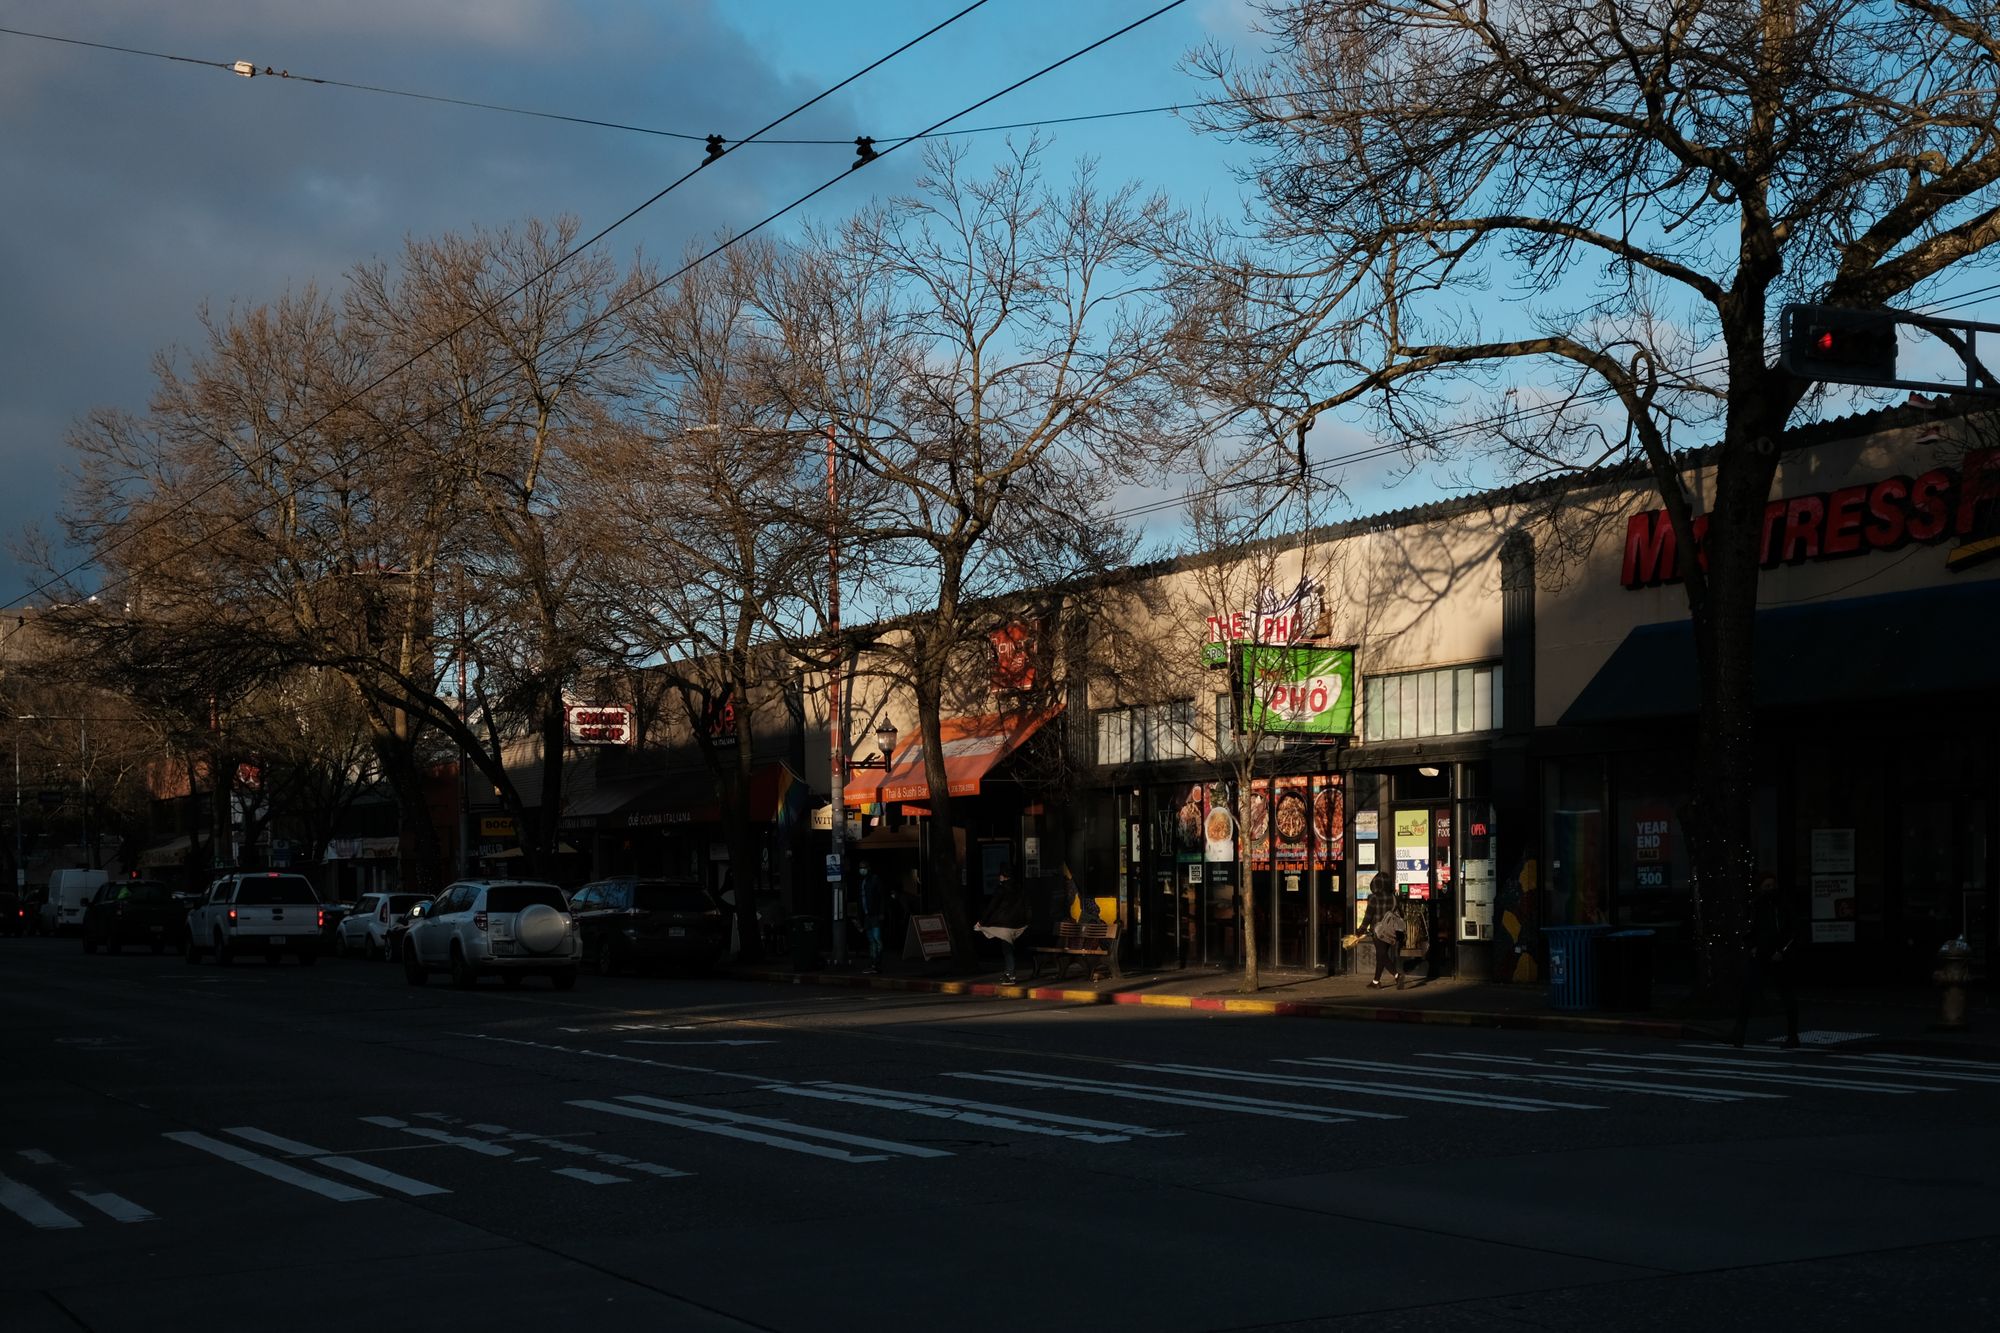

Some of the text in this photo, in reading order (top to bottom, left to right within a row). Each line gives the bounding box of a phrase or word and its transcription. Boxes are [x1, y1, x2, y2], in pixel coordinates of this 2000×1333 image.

[1620, 466, 1952, 590] MTRESS
[1206, 611, 1244, 642] THE
[576, 711, 627, 725] SMOKE
[580, 727, 624, 741] SHOP
[885, 788, 897, 799] Thai
[897, 787, 903, 799] &
[902, 786, 917, 798] Sushi
[1470, 823, 1487, 837] OPEN
[1636, 820, 1667, 835] YEAR
[1637, 834, 1661, 848] END
[1397, 861, 1409, 870] SOUL
